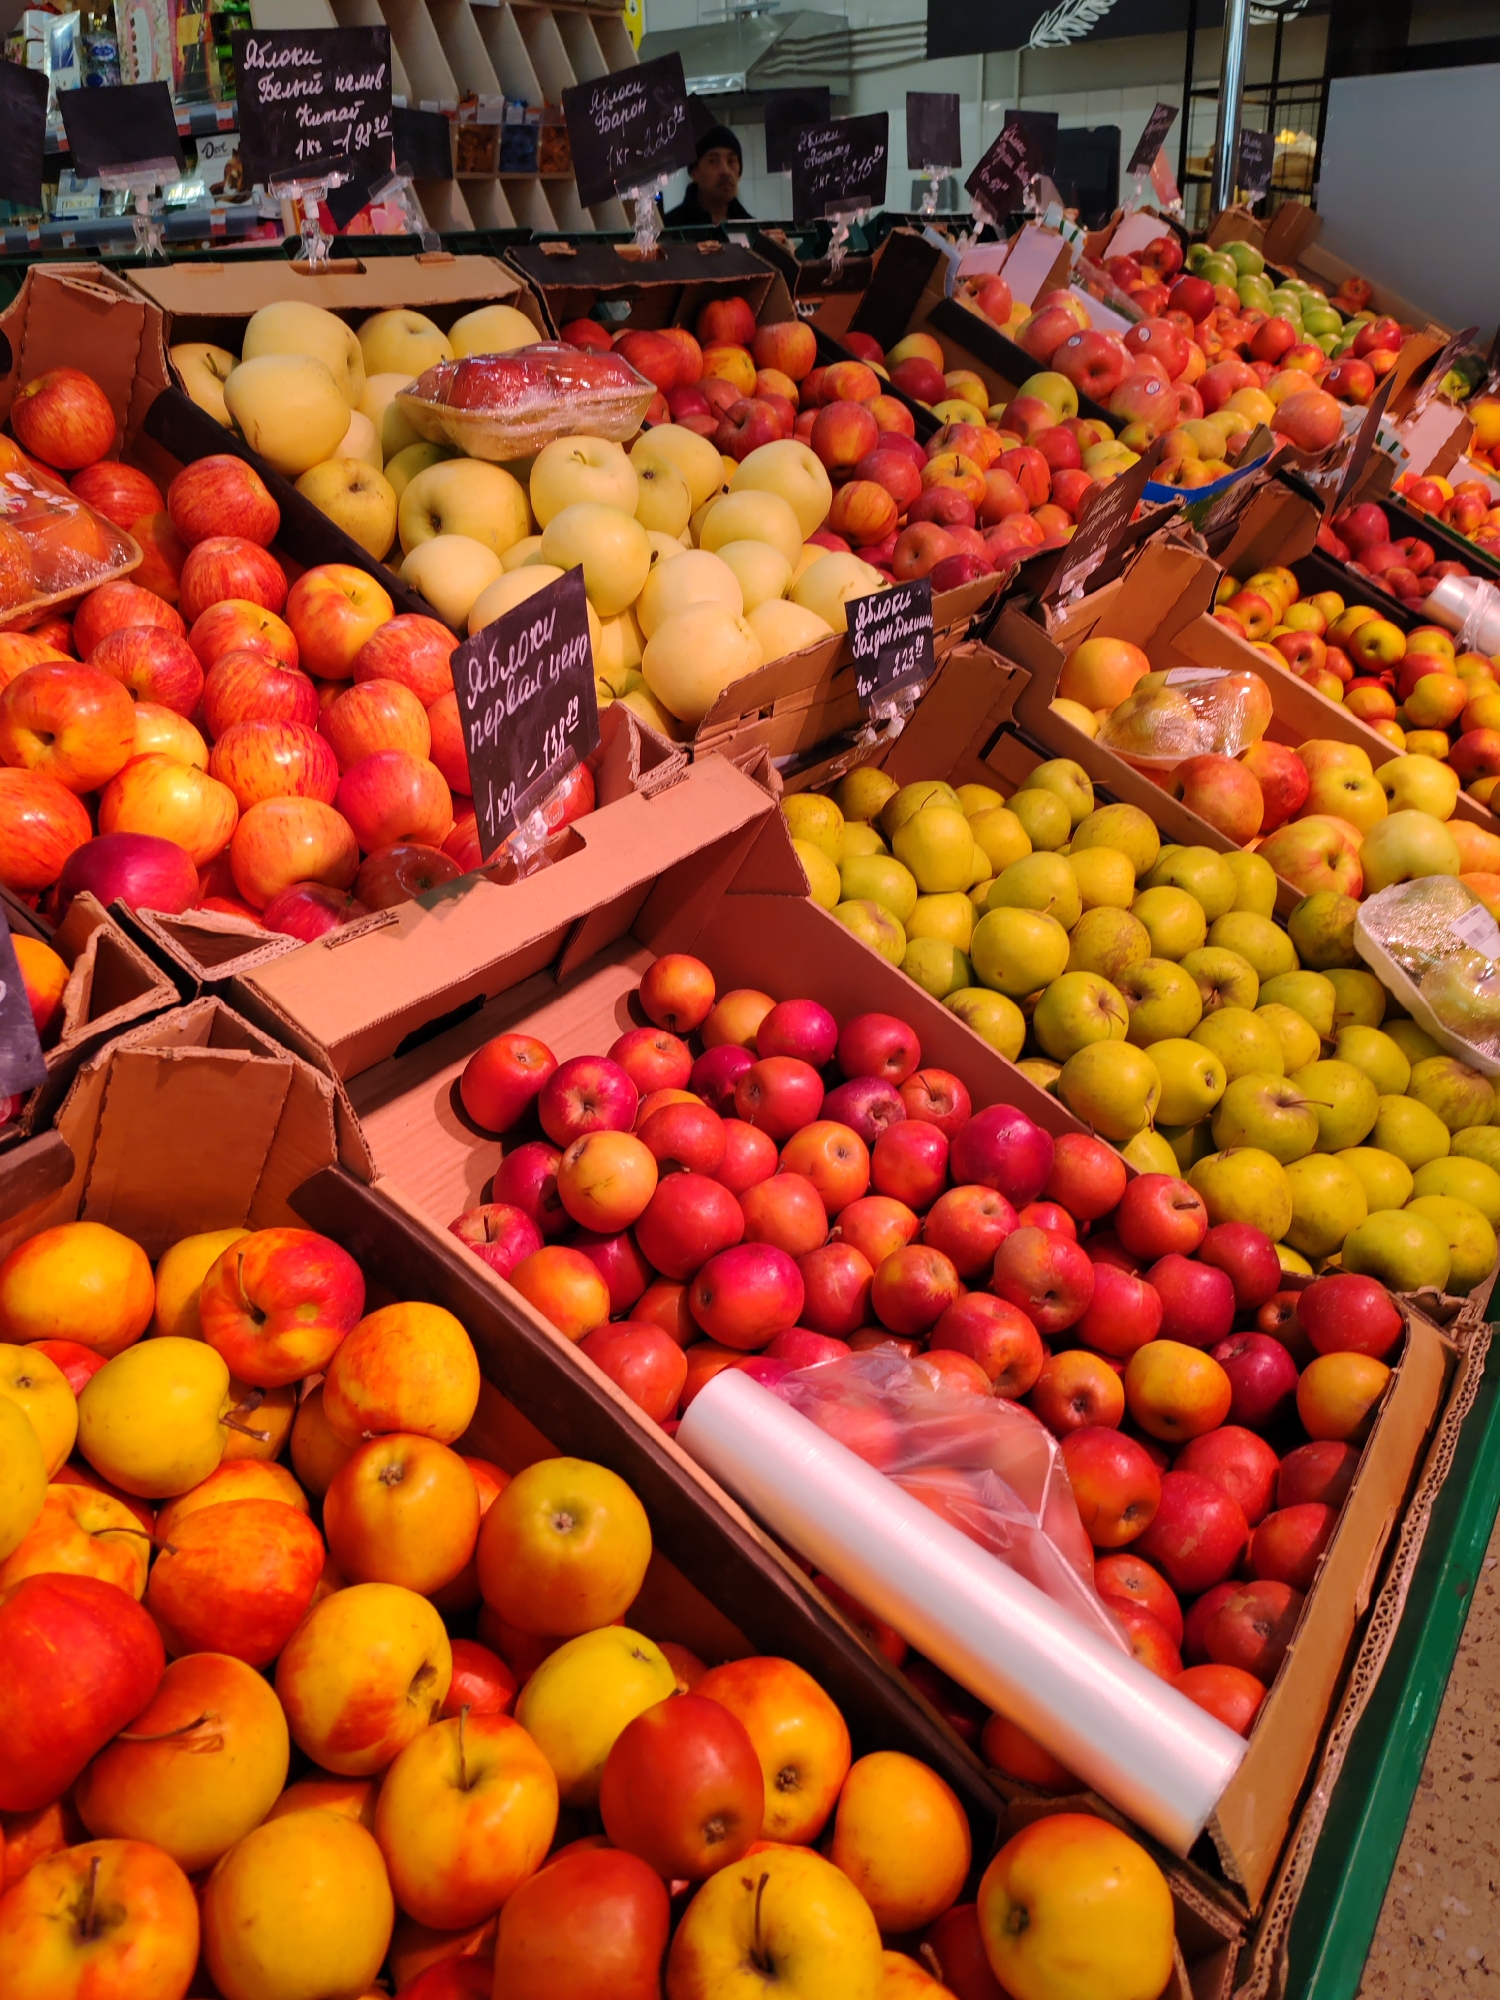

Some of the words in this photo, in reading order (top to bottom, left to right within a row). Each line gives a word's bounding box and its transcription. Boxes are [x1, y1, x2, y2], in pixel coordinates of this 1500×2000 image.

[243, 38, 322, 70] Яблоки
[258, 71, 323, 104] Белый
[335, 63, 385, 92] налив
[589, 81, 647, 115] Яблоки
[296, 100, 365, 128] Китай
[595, 98, 647, 137] Барон
[201, 141, 228, 160] Dove
[855, 589, 912, 632] Яблоки
[467, 607, 557, 710] Яблоки
[852, 623, 894, 660] Голден
[470, 661, 544, 755] первая
[549, 632, 589, 684] цена
